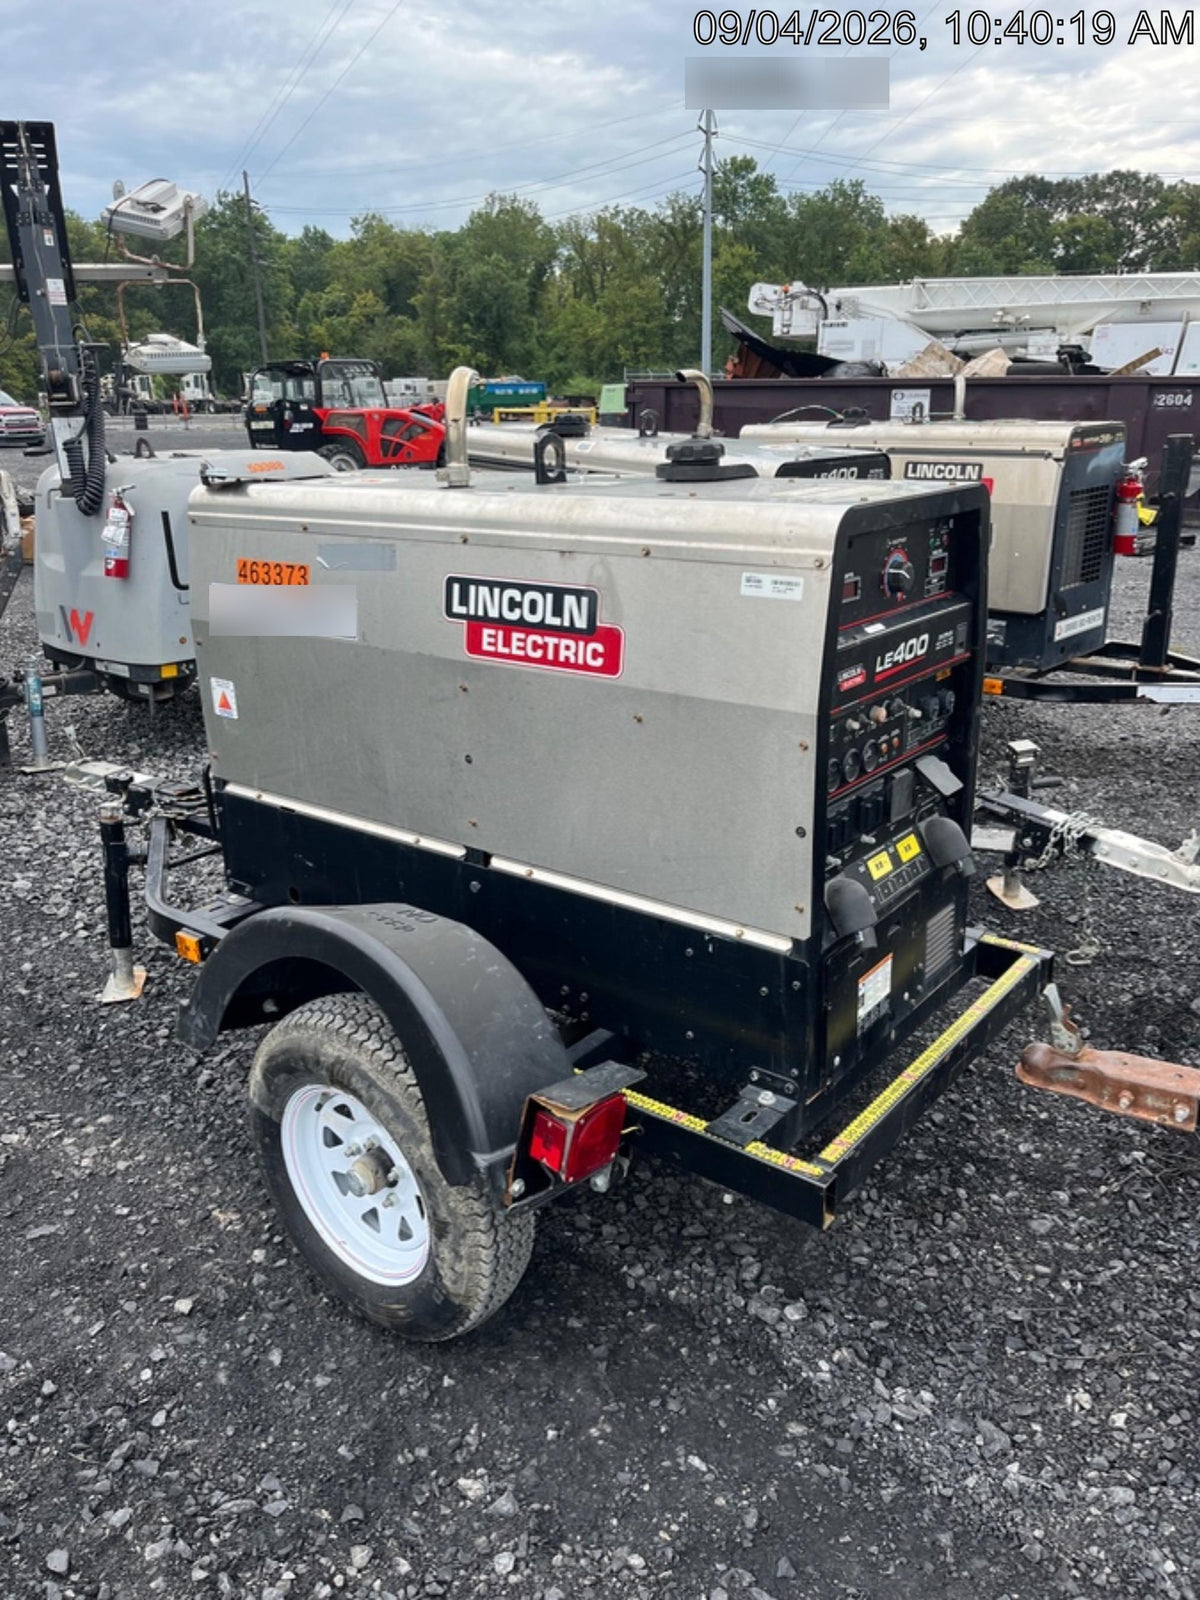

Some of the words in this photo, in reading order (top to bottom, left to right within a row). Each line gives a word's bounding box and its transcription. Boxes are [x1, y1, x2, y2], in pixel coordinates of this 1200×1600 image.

[907, 463, 980, 480] LINCOLN
[237, 560, 309, 585] 463373
[451, 582, 589, 629] LINCOLN
[481, 627, 605, 667] ELECTRIC
[875, 632, 929, 673] LE400
